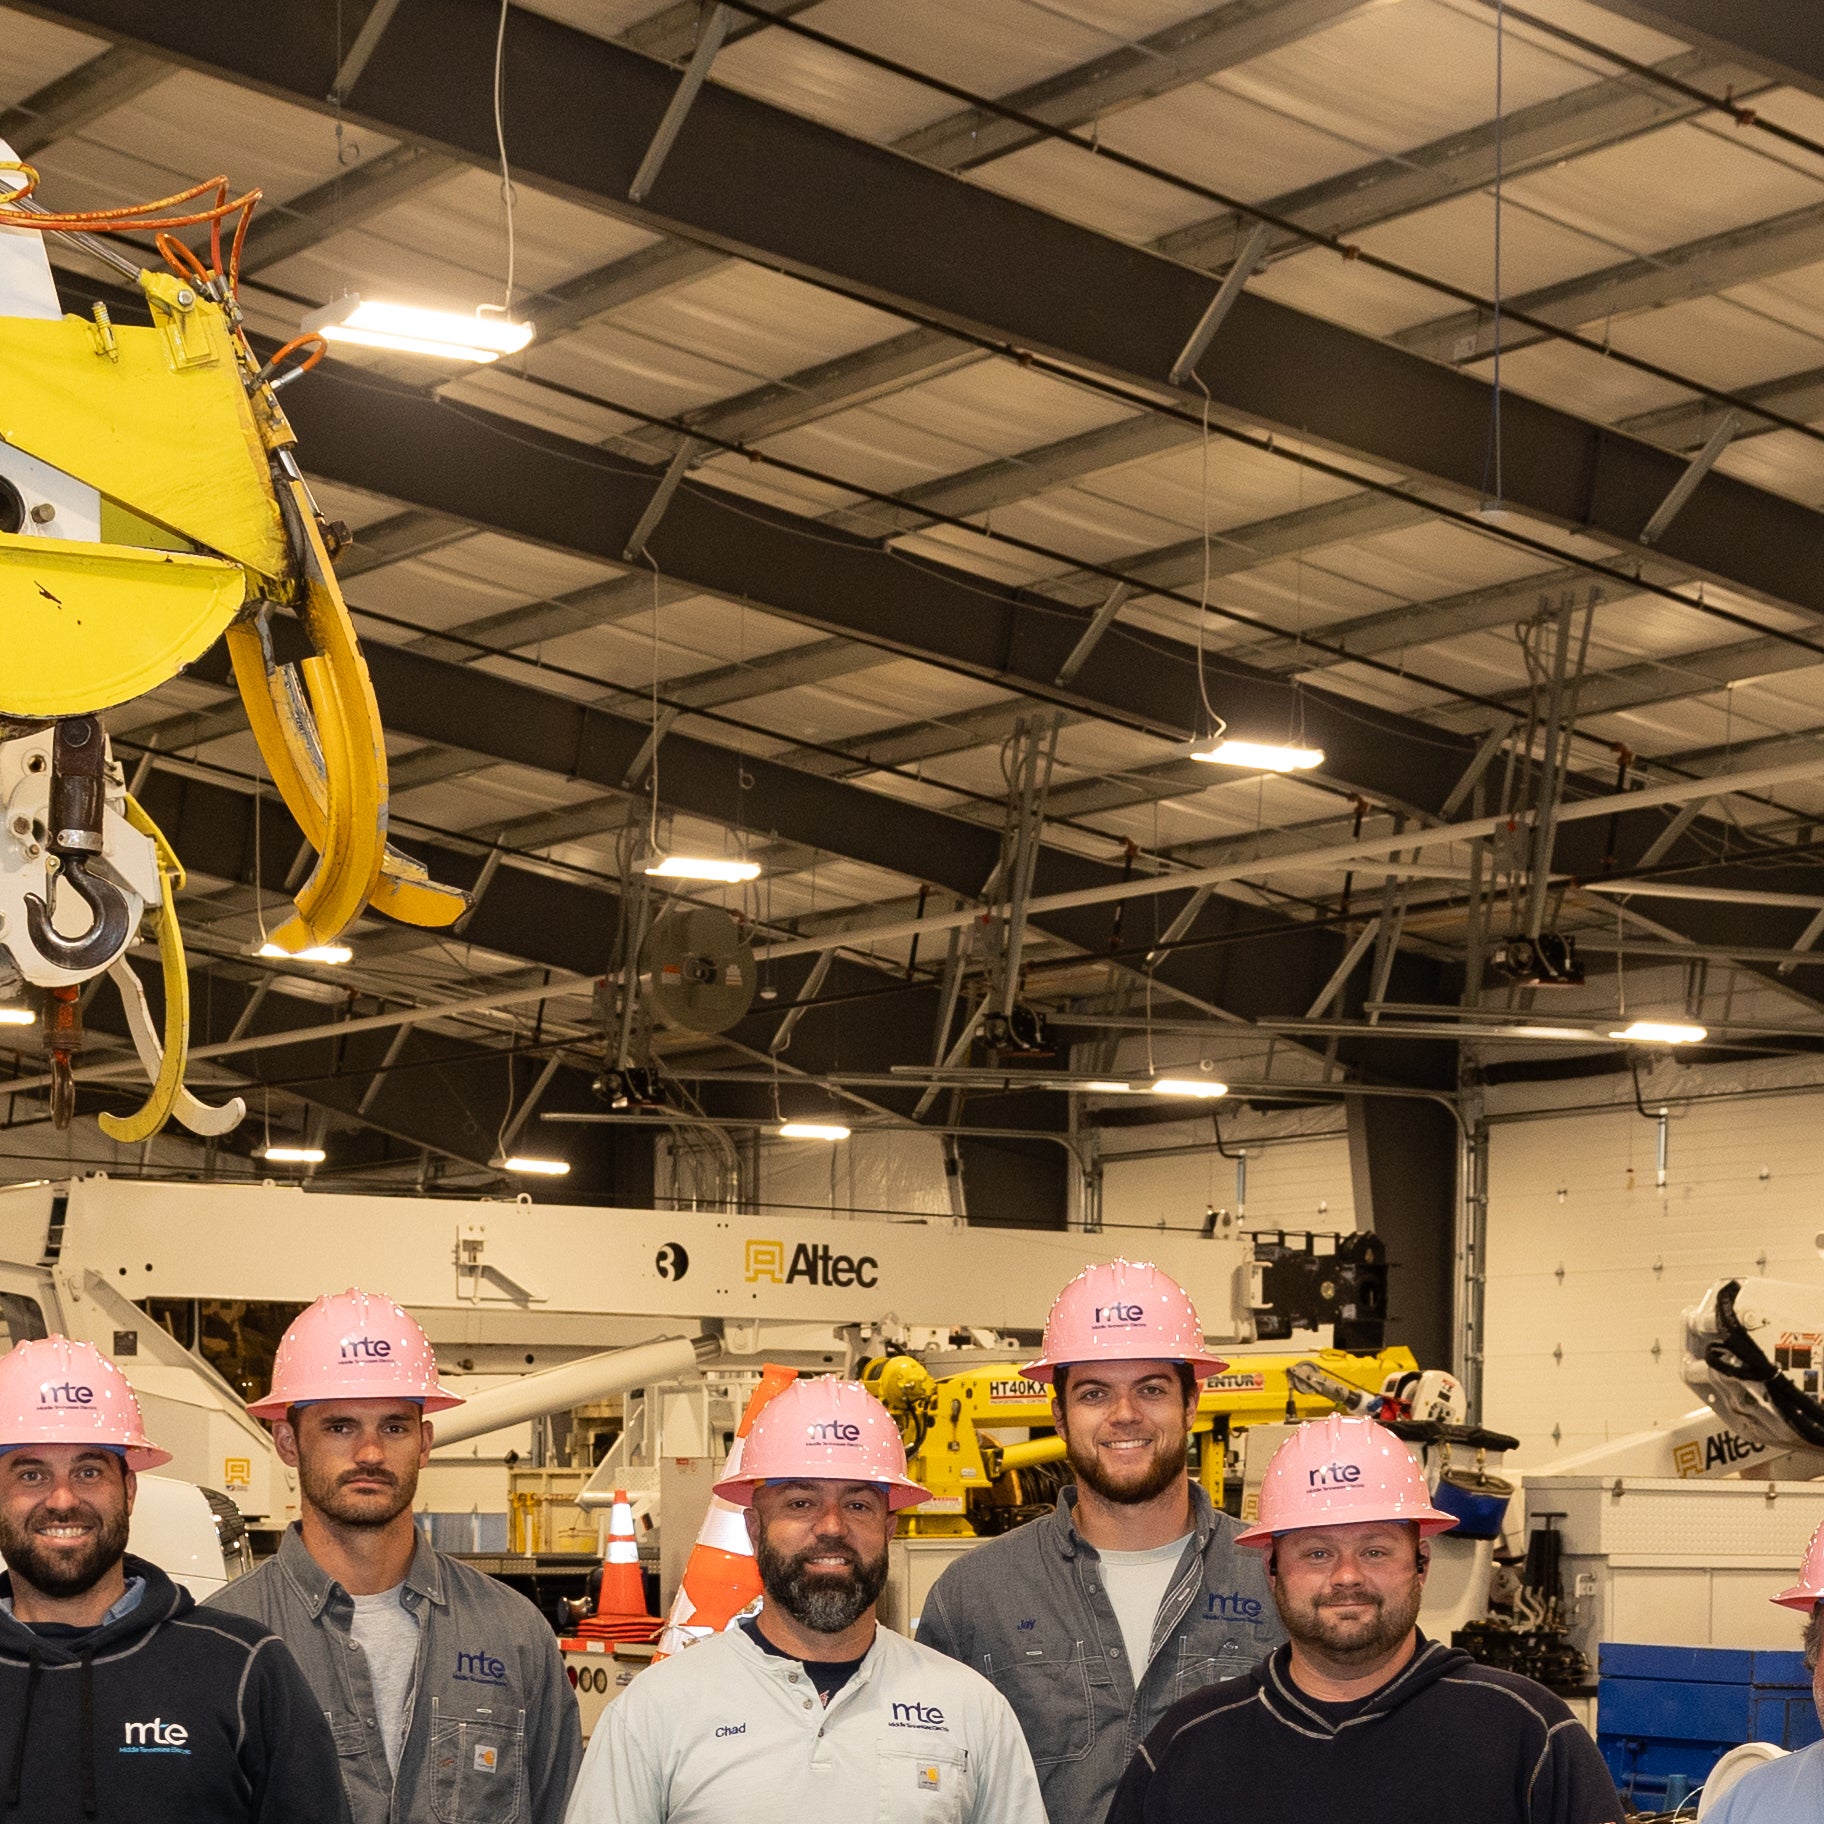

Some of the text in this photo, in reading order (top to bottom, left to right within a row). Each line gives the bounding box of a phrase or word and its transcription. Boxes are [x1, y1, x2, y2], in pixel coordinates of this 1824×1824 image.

[785, 1242, 879, 1288] Altec
[989, 1380, 1047, 1396] HT40KX
[1197, 1373, 1264, 1391] ENTURO
[1208, 1591, 1262, 1617] mte
[457, 1650, 506, 1678] mte
[892, 1701, 945, 1725] mte
[124, 1717, 189, 1746] mte
[714, 1722, 747, 1739] Chad
